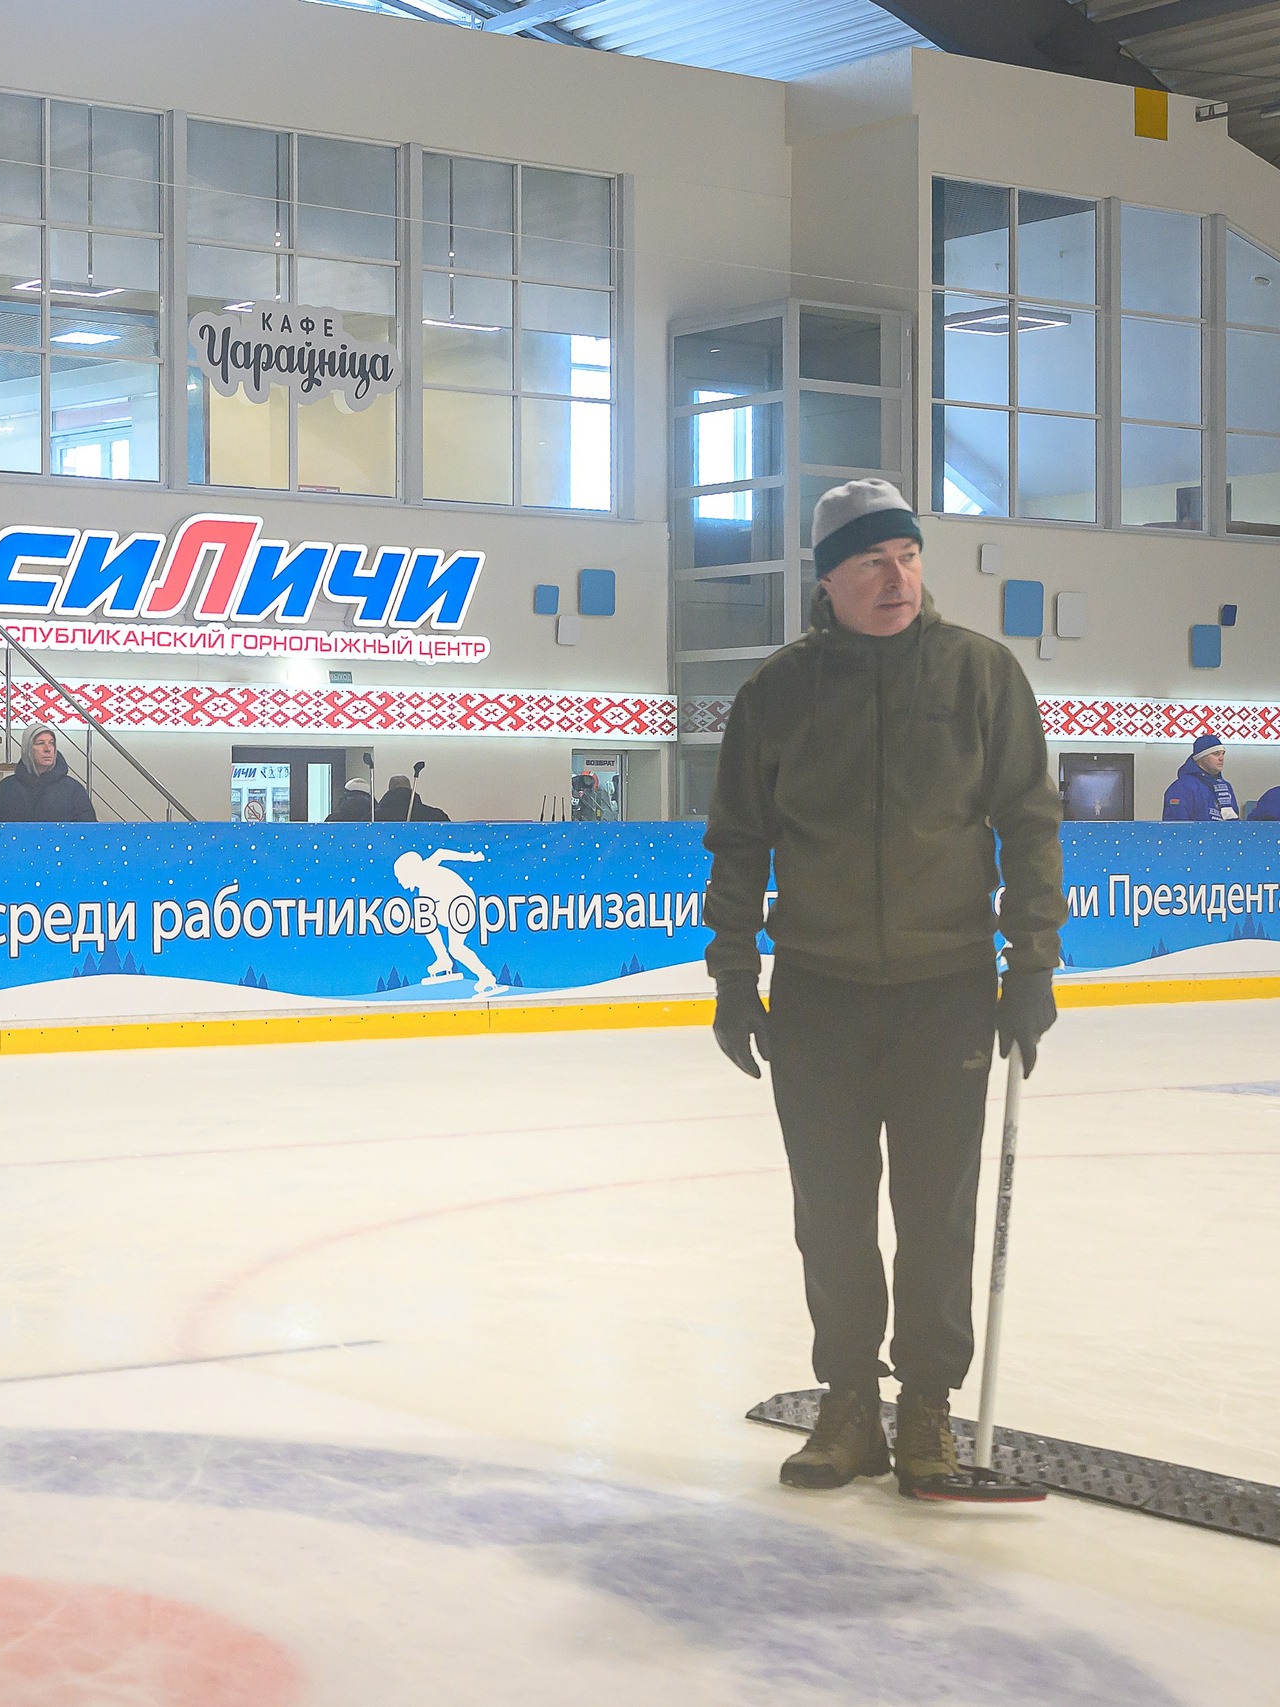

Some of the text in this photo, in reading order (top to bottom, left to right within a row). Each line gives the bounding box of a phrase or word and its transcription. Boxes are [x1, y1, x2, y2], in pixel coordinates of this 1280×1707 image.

[262, 313, 333, 337] КАФЕ
[199, 324, 394, 399] Чараўніца
[231, 634, 412, 655] ГОРНОЛЫЖНЫЙ
[419, 641, 485, 659] ЦЕНТР
[585, 759, 615, 767] ВОЗВРАТ
[152, 882, 438, 954] работников
[448, 880, 706, 946] организаци
[1108, 873, 1280, 928] Президент
